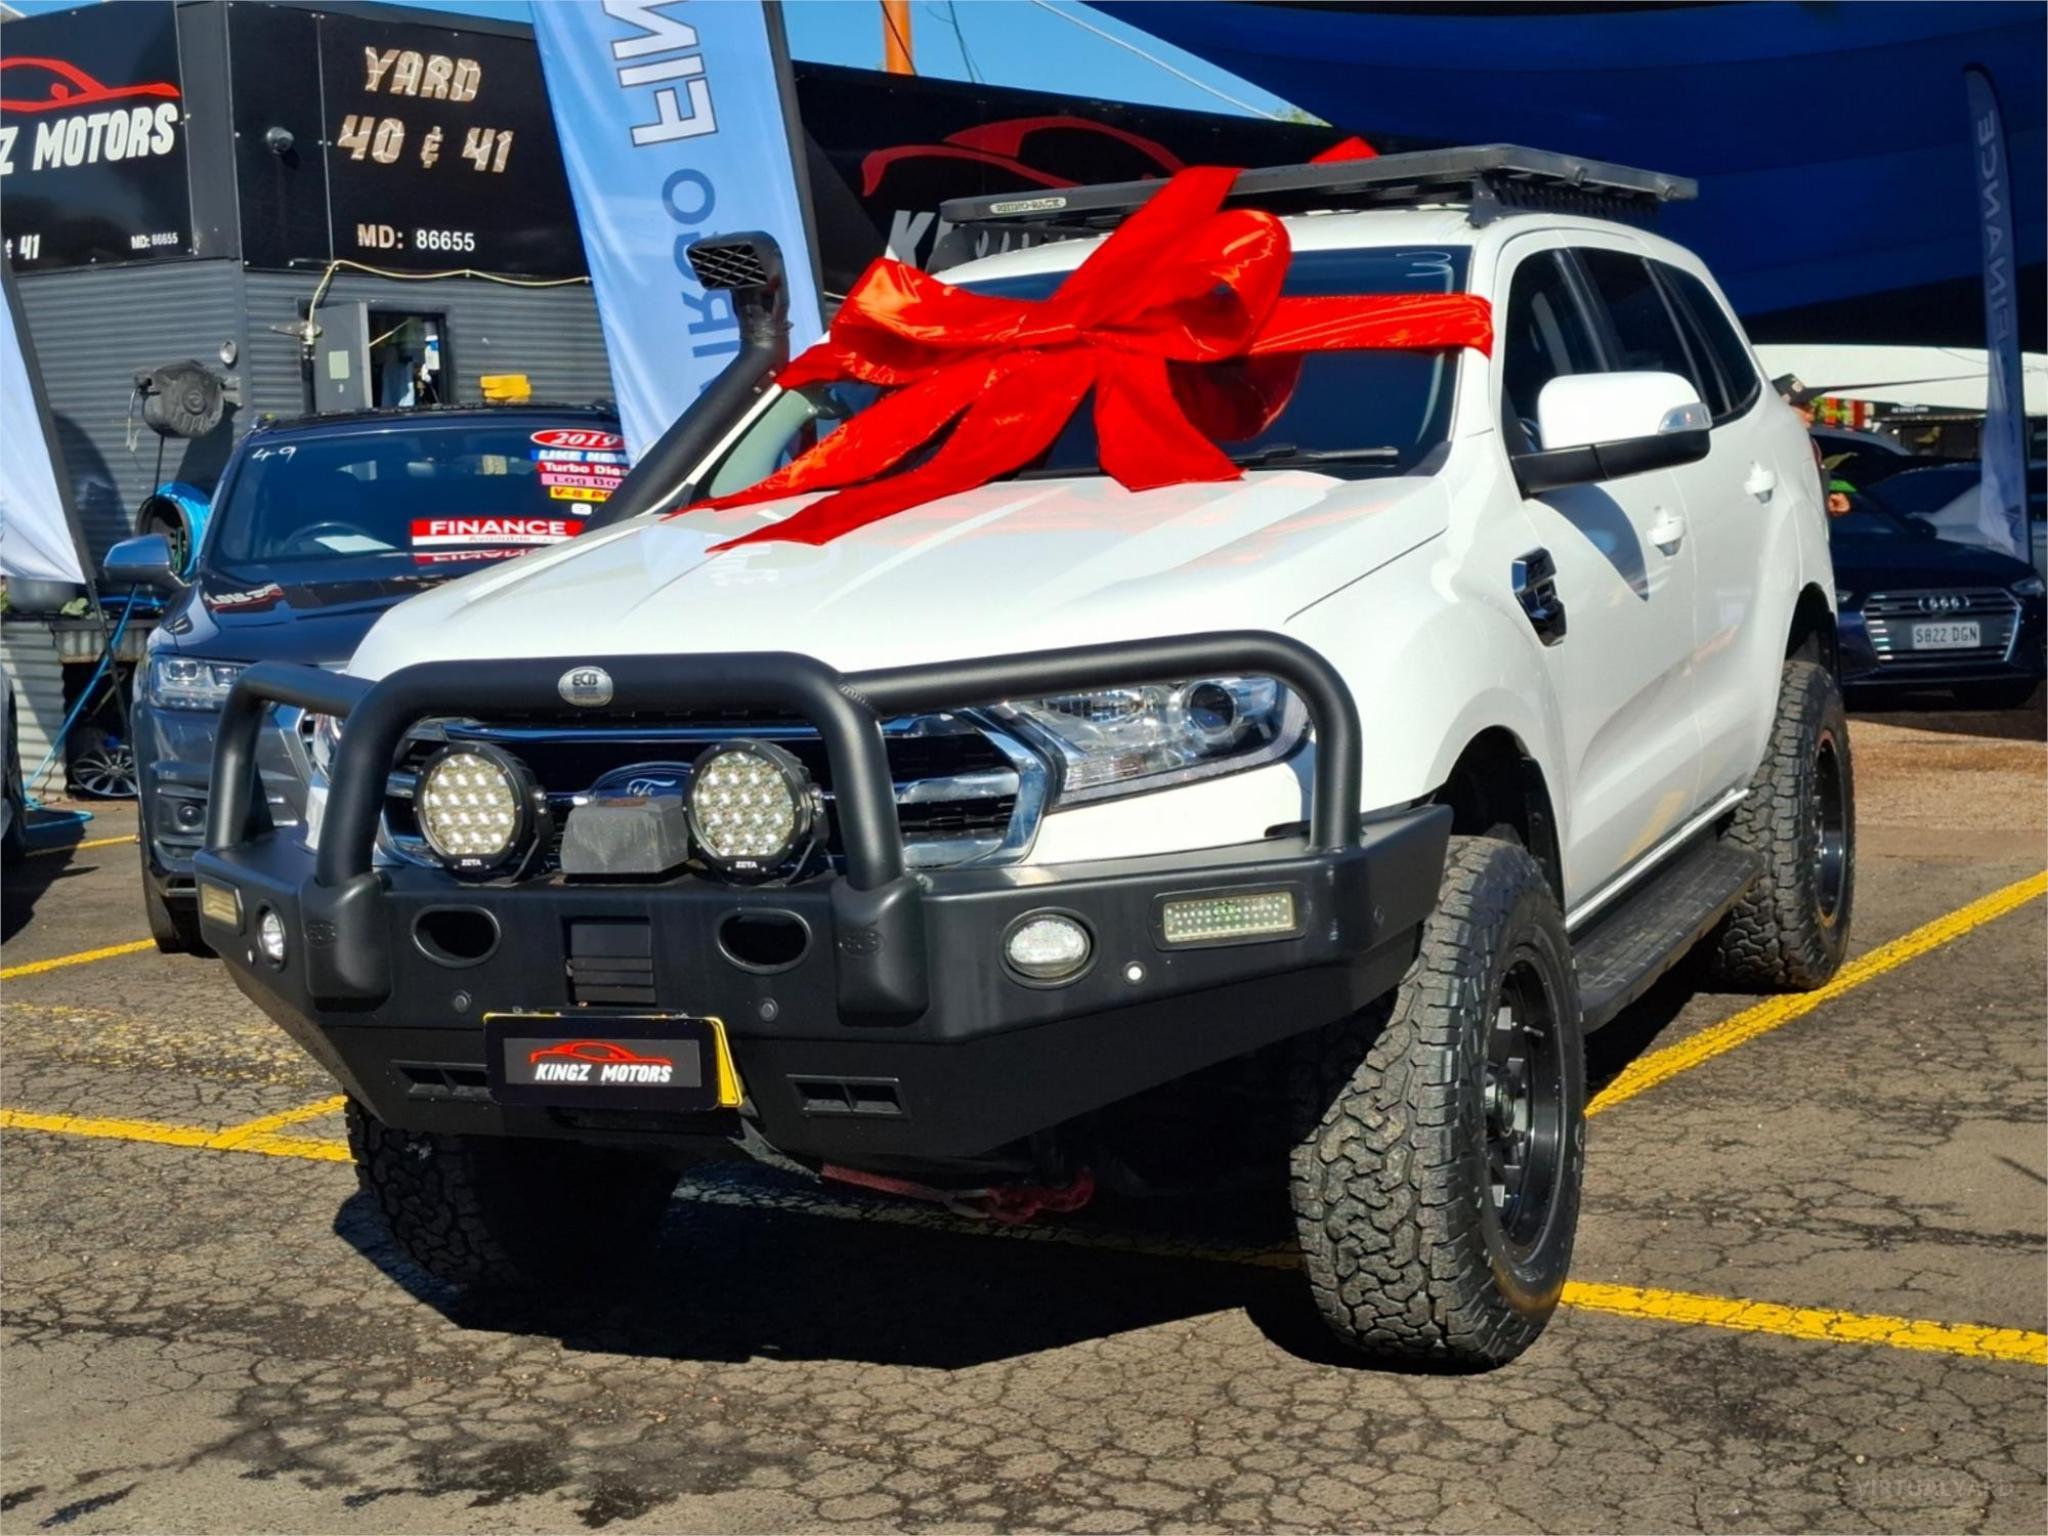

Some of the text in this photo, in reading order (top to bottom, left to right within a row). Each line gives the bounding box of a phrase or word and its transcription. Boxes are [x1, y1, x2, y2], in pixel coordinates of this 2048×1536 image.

[364, 46, 482, 102] YARD
[32, 102, 179, 171] MOTORS
[337, 115, 514, 173] 40 & 41
[131, 235, 151, 249] MD:
[357, 224, 476, 252] MD: 86655
[19, 234, 40, 260] 41
[550, 432, 619, 447] 2019
[543, 462, 590, 474] Turbo
[553, 475, 586, 487] Log
[430, 520, 567, 535] FINANCE
[1951, 626, 1978, 642] DGN
[461, 858, 482, 867] ZETA
[735, 860, 758, 869] ZETA
[534, 1063, 673, 1083] KINGZ MOTORS
